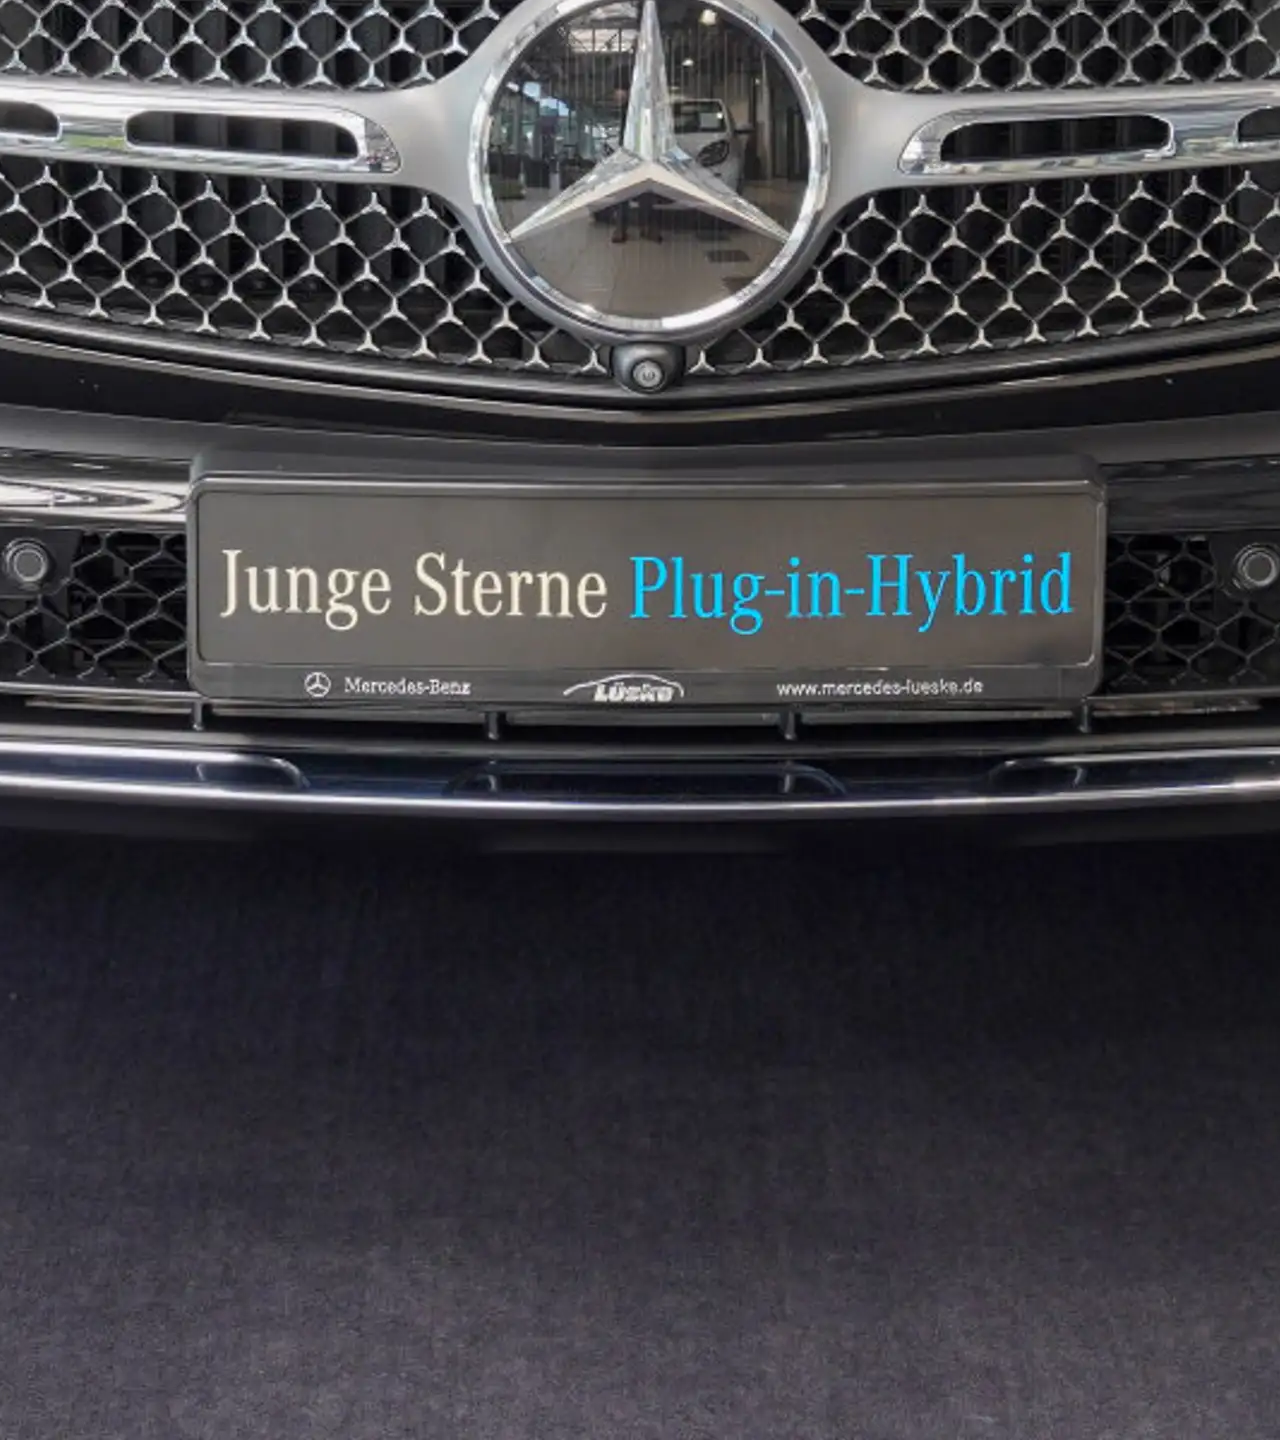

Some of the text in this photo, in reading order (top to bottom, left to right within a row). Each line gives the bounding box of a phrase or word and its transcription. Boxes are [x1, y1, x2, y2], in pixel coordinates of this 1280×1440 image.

[220, 549, 1073, 635] Junge Sterne Plug-in-Hybrid
[344, 676, 472, 696] Mercedes-Benz
[776, 677, 984, 697] www.mercedes-lueske.de
